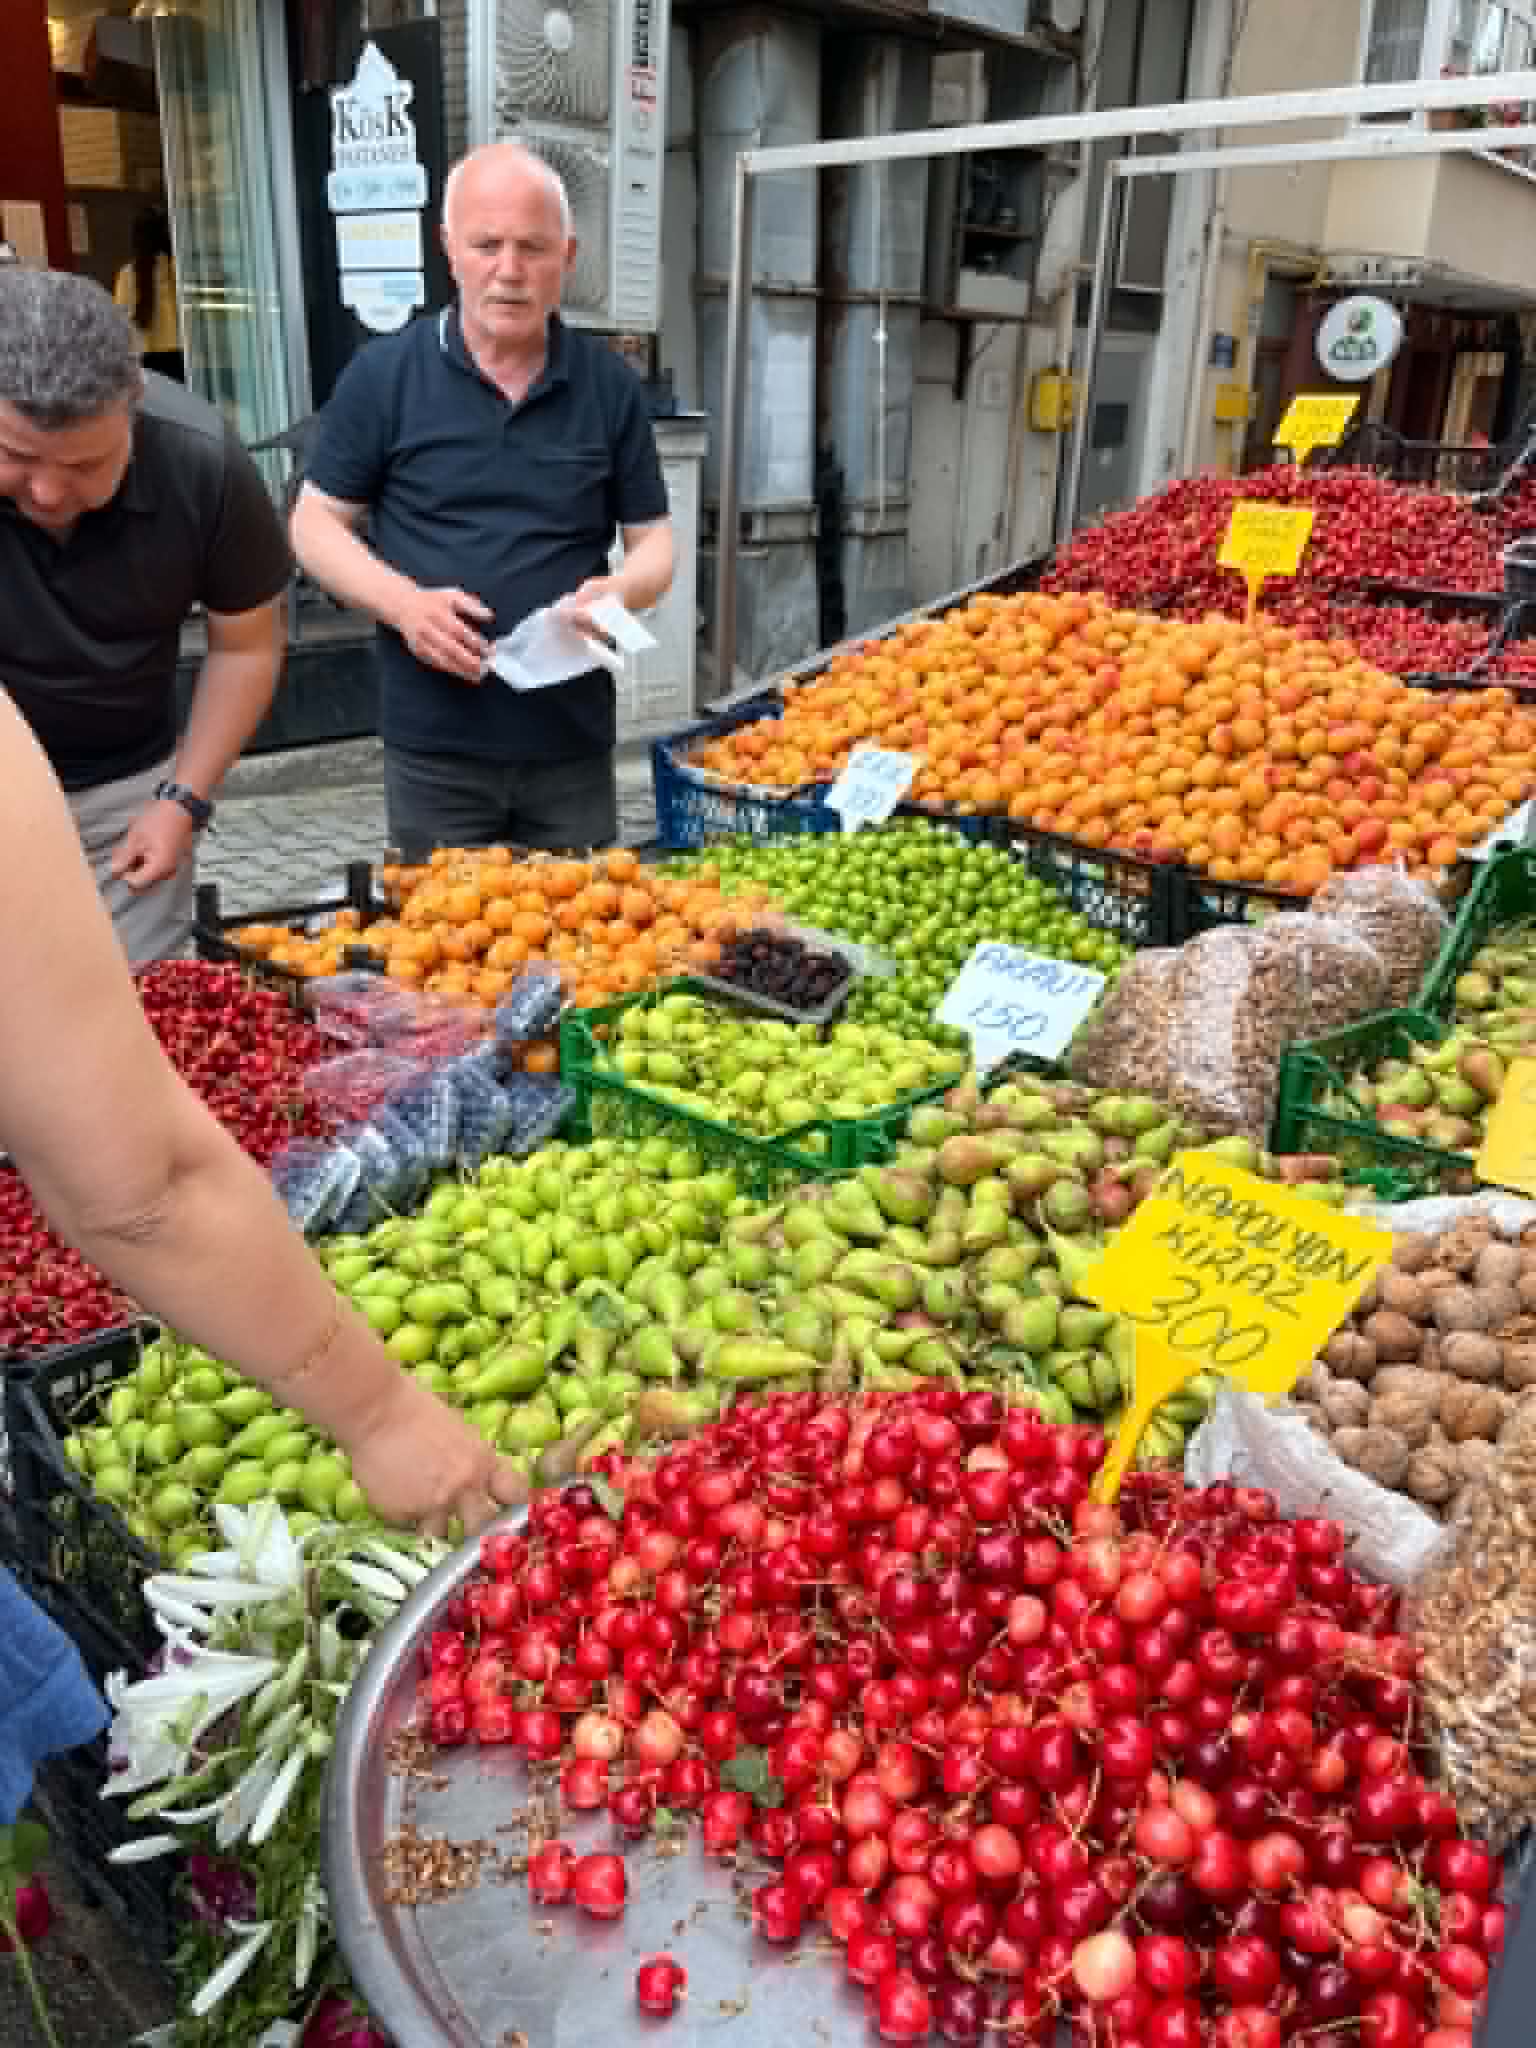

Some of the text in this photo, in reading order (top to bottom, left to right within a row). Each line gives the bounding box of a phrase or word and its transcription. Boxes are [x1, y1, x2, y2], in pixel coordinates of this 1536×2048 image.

[967, 997, 1049, 1040] 150
[1158, 1167, 1373, 1284] NAPOLYON
[1120, 1275, 1269, 1365] 300
